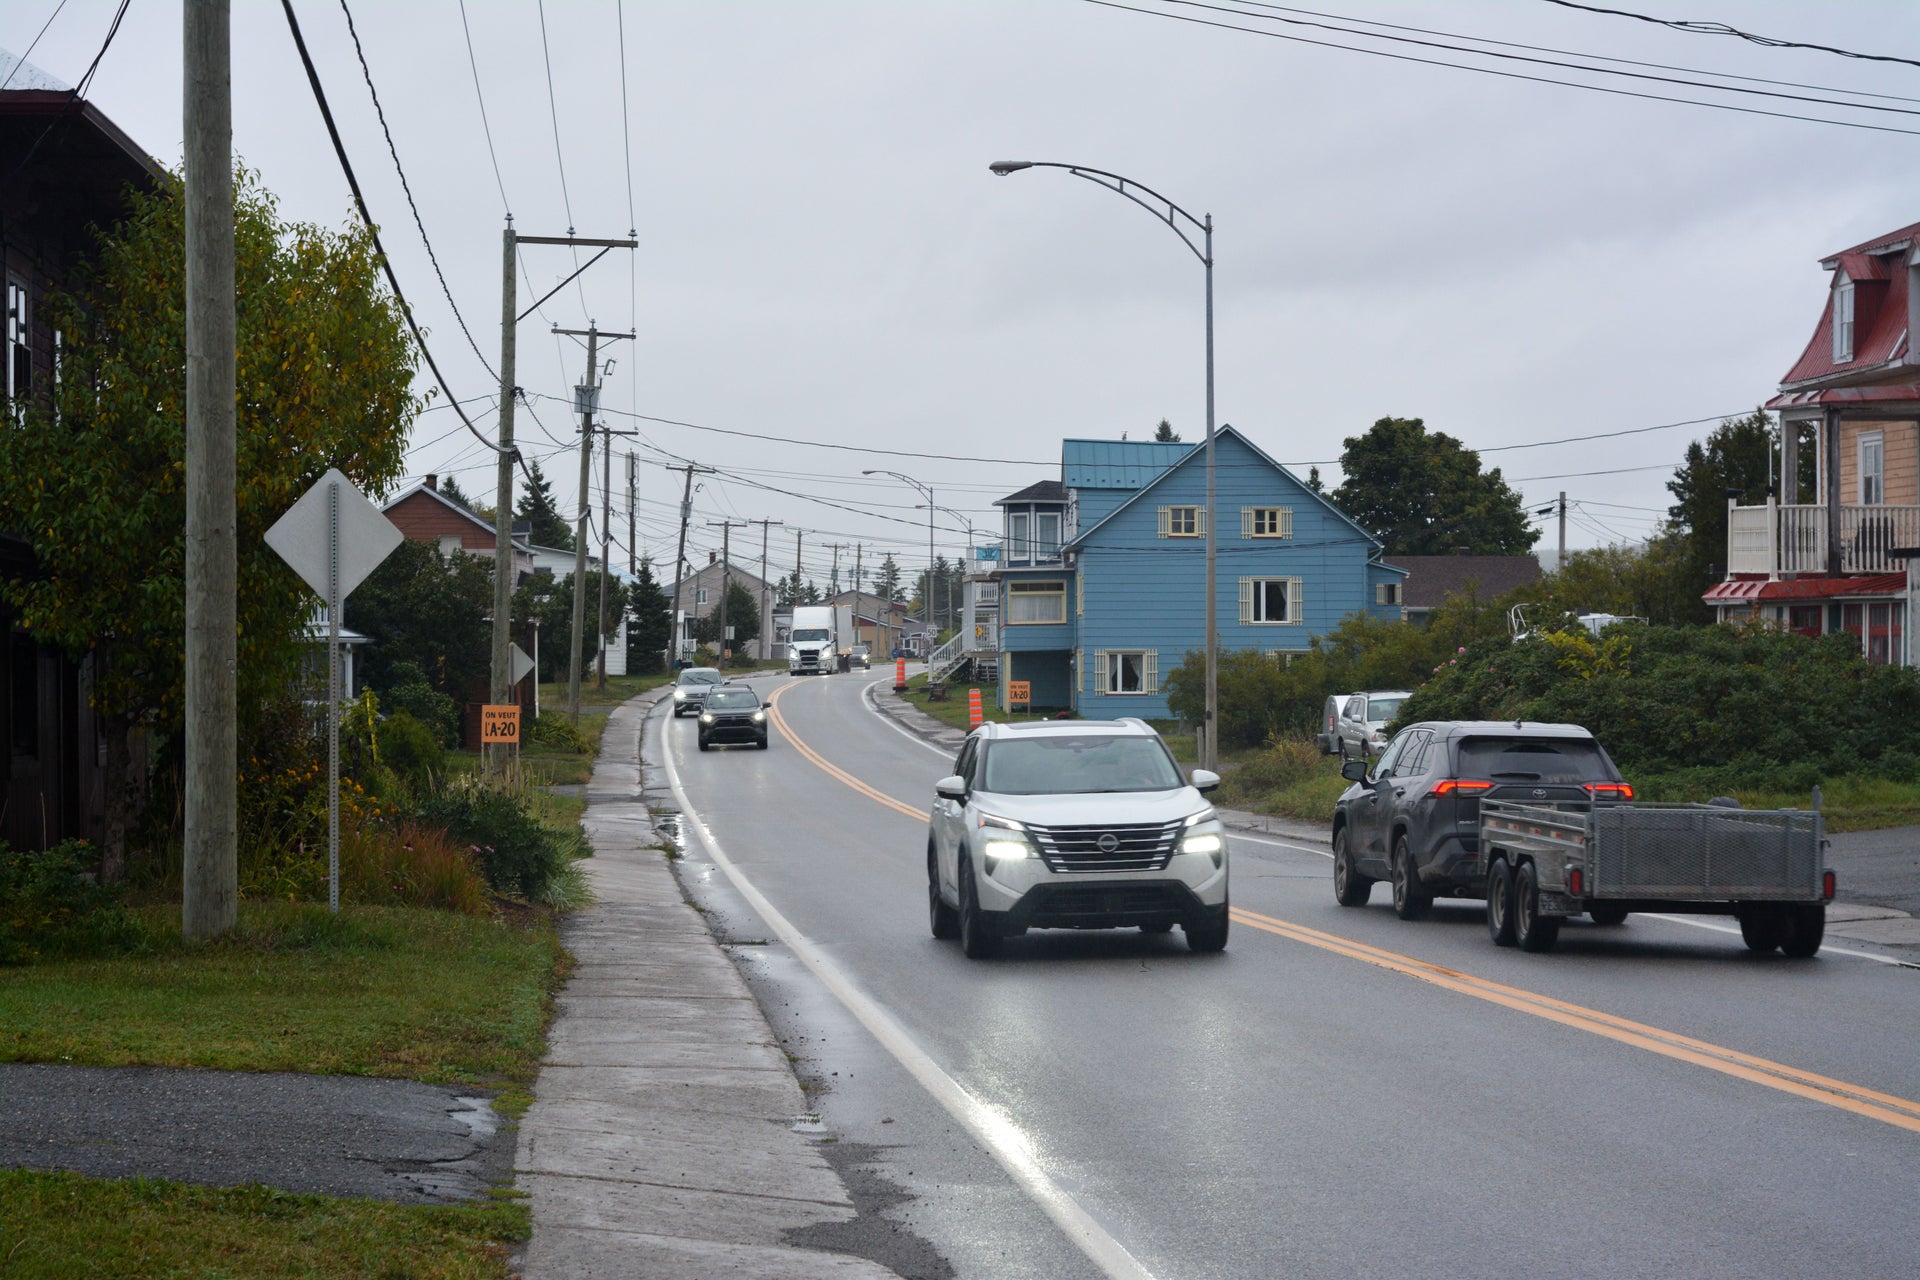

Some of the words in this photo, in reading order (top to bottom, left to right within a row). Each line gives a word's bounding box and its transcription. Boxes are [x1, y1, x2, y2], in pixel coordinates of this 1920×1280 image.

[928, 628, 936, 636] 50
[485, 711, 496, 719] ON
[498, 711, 516, 719] VEUT
